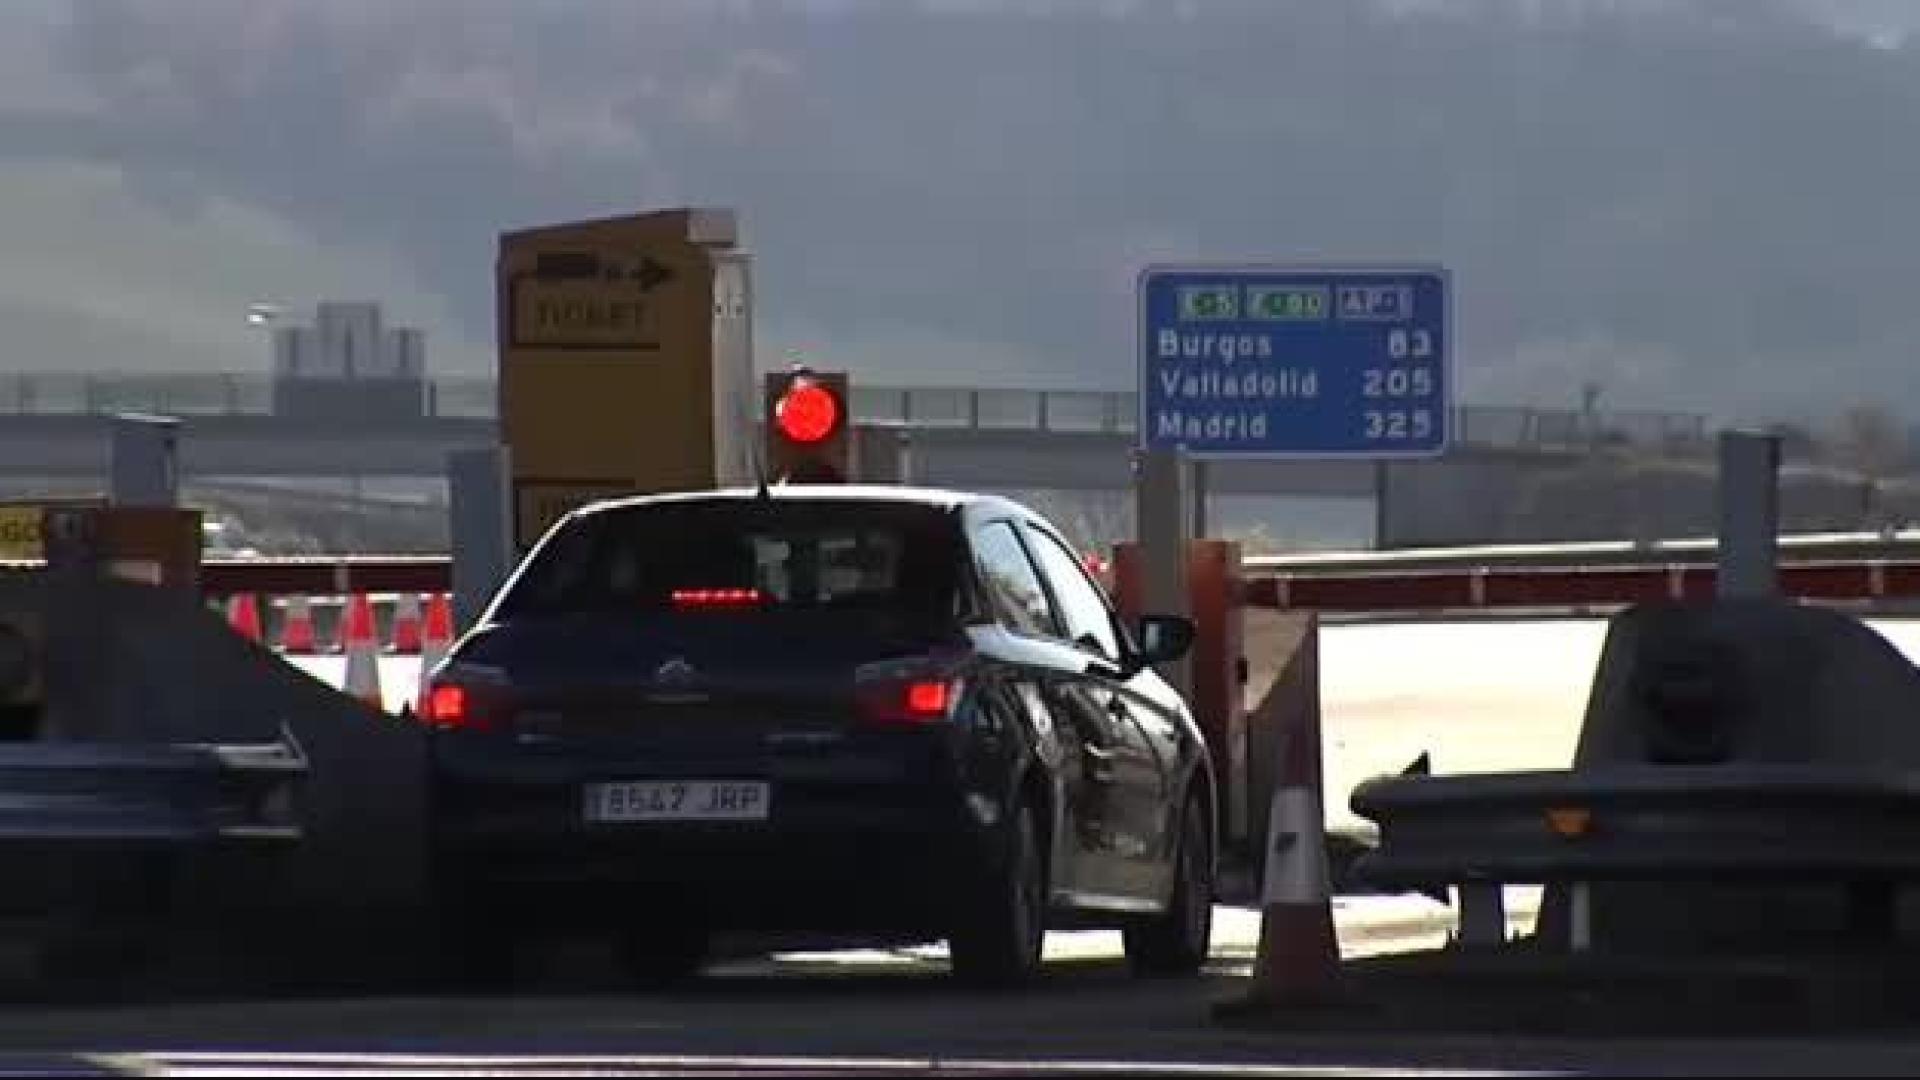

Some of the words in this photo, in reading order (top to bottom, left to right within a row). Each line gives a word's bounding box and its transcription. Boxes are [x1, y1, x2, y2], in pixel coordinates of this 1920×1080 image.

[1158, 330, 1271, 366] Burgos
[1159, 367, 1318, 398] Valladolid
[1363, 369, 1432, 396] 205
[1158, 411, 1267, 439] Madrid
[1364, 411, 1432, 439] 325
